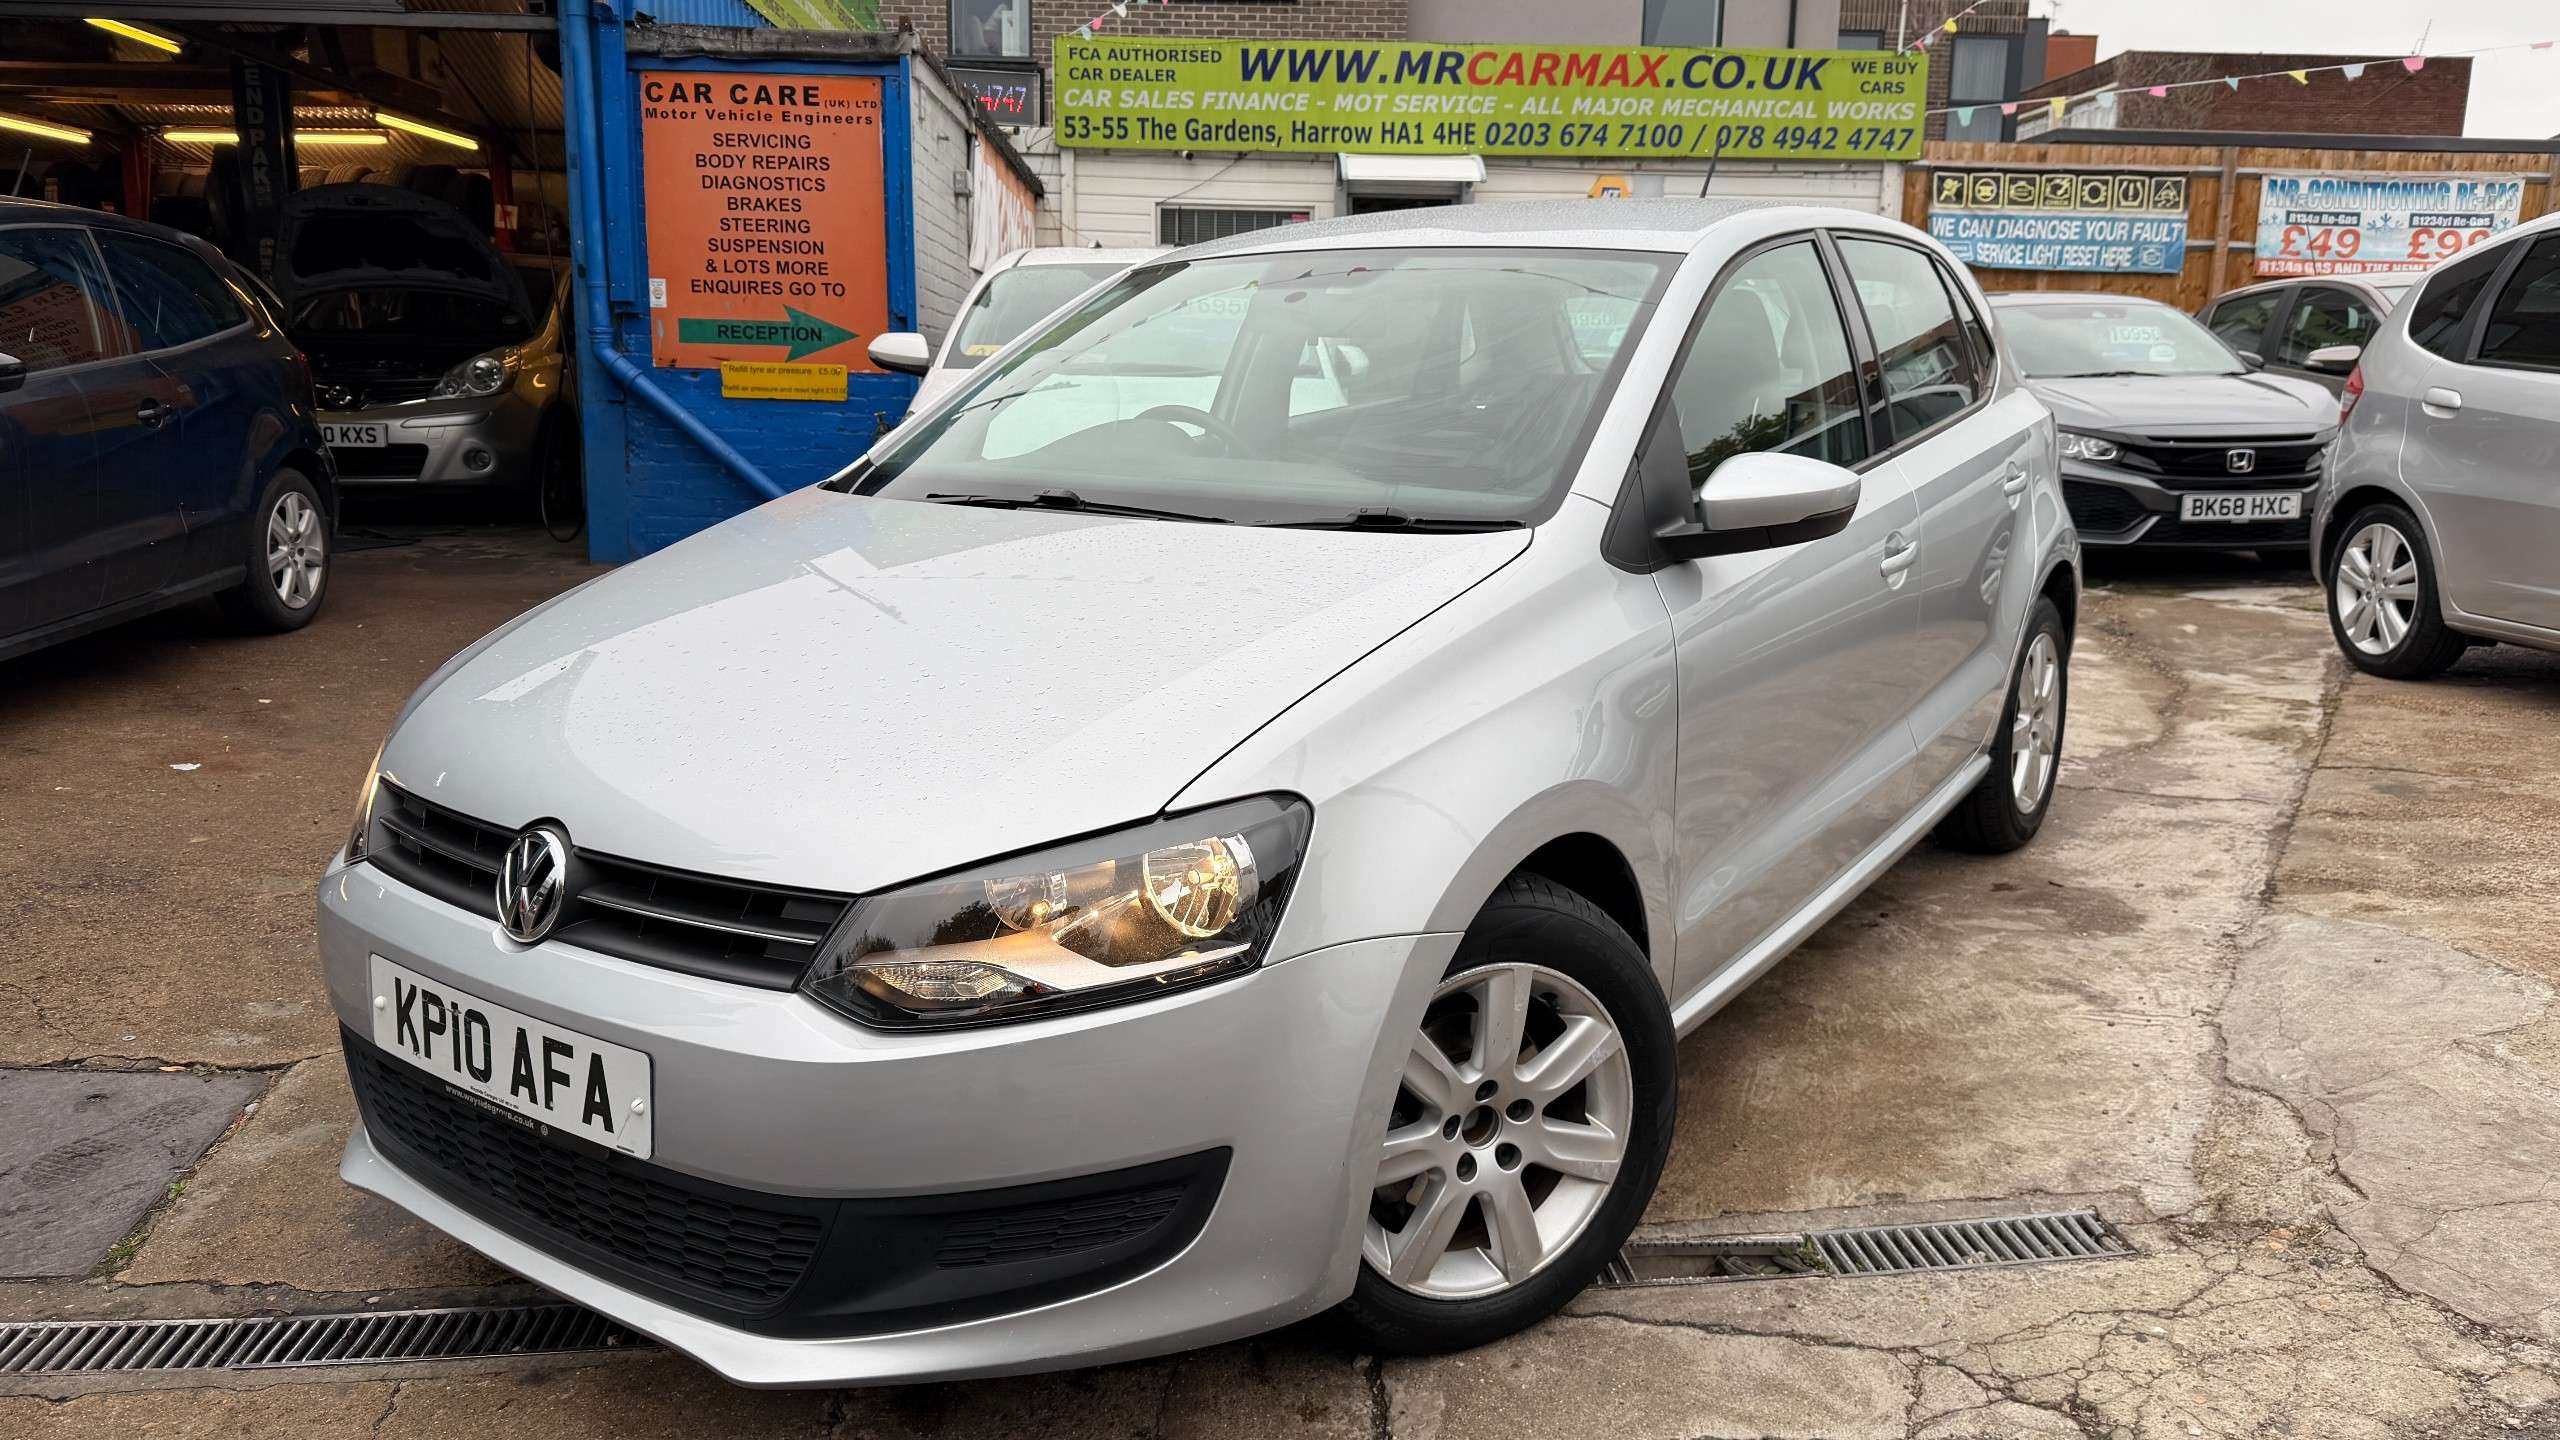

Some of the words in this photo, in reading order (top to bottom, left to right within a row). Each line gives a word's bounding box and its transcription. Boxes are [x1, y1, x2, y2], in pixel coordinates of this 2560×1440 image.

[1069, 47, 1101, 61] FCA
[1107, 48, 1222, 63] AUTHORISED
[1069, 67, 1103, 81] CAR
[1110, 68, 1176, 82] DEALER
[1241, 48, 1830, 91] WWW.MRCARMAX.CO.UK
[1851, 61, 1877, 74] WE
[1883, 61, 1918, 75] BUY
[644, 81, 713, 104] CAR
[729, 83, 821, 107] CARE
[824, 99, 850, 109] (UK)
[855, 100, 878, 109] LTD
[1860, 80, 1905, 94] CARS
[1063, 88, 1113, 108] CAR
[1119, 90, 1195, 110] SALES
[1201, 91, 1311, 112] FINANCE
[1334, 93, 1388, 113] MOT
[1392, 94, 1498, 114] SERVICE
[1520, 95, 1563, 115] ALL
[1571, 96, 1655, 117] MAJOR
[1660, 98, 1818, 119] MECHANICAL
[1827, 102, 1917, 121] WORKS
[645, 108, 697, 121] Motor
[705, 109, 773, 123] Vehicle
[782, 111, 873, 126] Engineers
[713, 133, 811, 149] SERVICING
[1064, 115, 1129, 140] 53-55
[1136, 117, 1177, 141] The
[1185, 118, 1282, 147] Gardens,
[1292, 120, 1373, 144] Harrow
[1381, 121, 1424, 145] HA1
[1433, 122, 1477, 145] 4HE
[1485, 122, 1551, 147] 0203
[1559, 123, 1609, 147] 674
[1618, 124, 1684, 148] 7100
[1690, 124, 1708, 153] /
[1716, 124, 1765, 149] 078
[1772, 126, 1839, 150] 4942
[1847, 128, 1915, 151] 4747
[695, 153, 745, 169] BODY
[752, 155, 830, 171] REPAIRS
[701, 174, 826, 192] DIAGNOSTICS
[727, 197, 802, 213] BRAKES
[720, 217, 811, 233] STEERING
[1932, 217, 1956, 237] WE
[1958, 217, 1994, 238] CAN
[1995, 219, 2082, 241] DIAGNOSE
[2085, 220, 2129, 241] YOUR
[2131, 222, 2184, 242] FAULT
[708, 238, 824, 255] SUSPENSION
[2279, 224, 2361, 259] £49
[1976, 242, 2025, 264] SERVICE
[2025, 244, 2061, 265] LIGHT
[2062, 245, 2100, 267] RESET
[2100, 246, 2133, 267] HERE
[705, 259, 717, 273] &
[723, 260, 770, 275] LOTS
[776, 261, 829, 276] MORE
[691, 279, 783, 296] ENQUIRES
[789, 282, 816, 296] GO
[822, 283, 846, 297] TO
[717, 325, 822, 341] RECEPTION
[340, 426, 377, 443] KXS
[2191, 498, 2245, 516] BK68
[2250, 497, 2291, 516] HXC
[394, 976, 493, 1084] KP10
[510, 1026, 615, 1134] AFA
